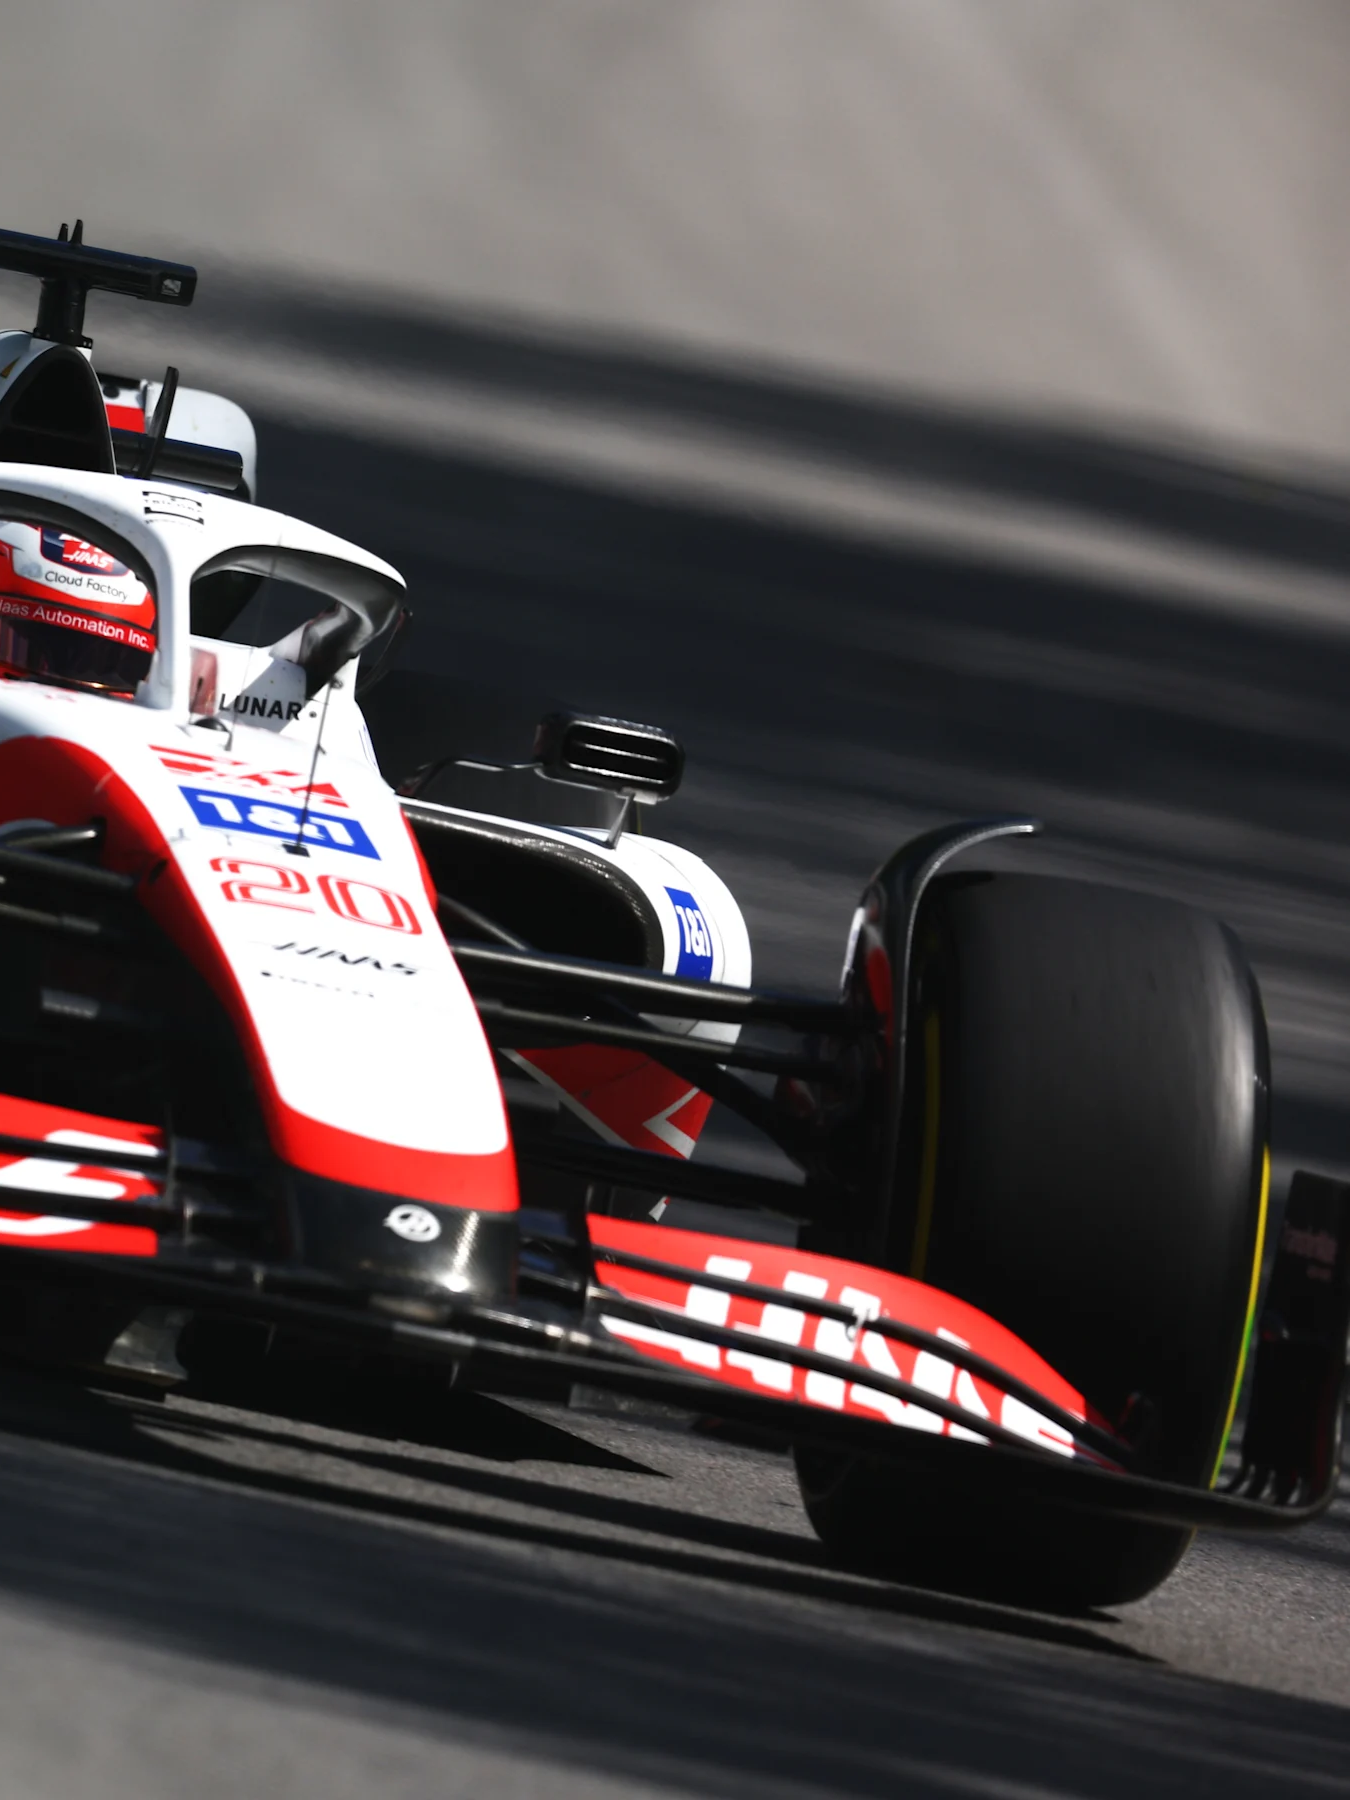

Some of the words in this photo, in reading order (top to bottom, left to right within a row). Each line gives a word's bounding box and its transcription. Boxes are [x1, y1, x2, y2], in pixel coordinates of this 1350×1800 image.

[62, 550, 114, 569] HAAS
[44, 571, 82, 587] Cloud
[86, 578, 128, 602] Factory
[34, 606, 125, 640] Automation
[129, 630, 150, 649] Inc.
[219, 693, 303, 720] LUNAR
[197, 794, 355, 847] 1&1
[209, 857, 422, 935] 20
[675, 904, 711, 958] 1&1
